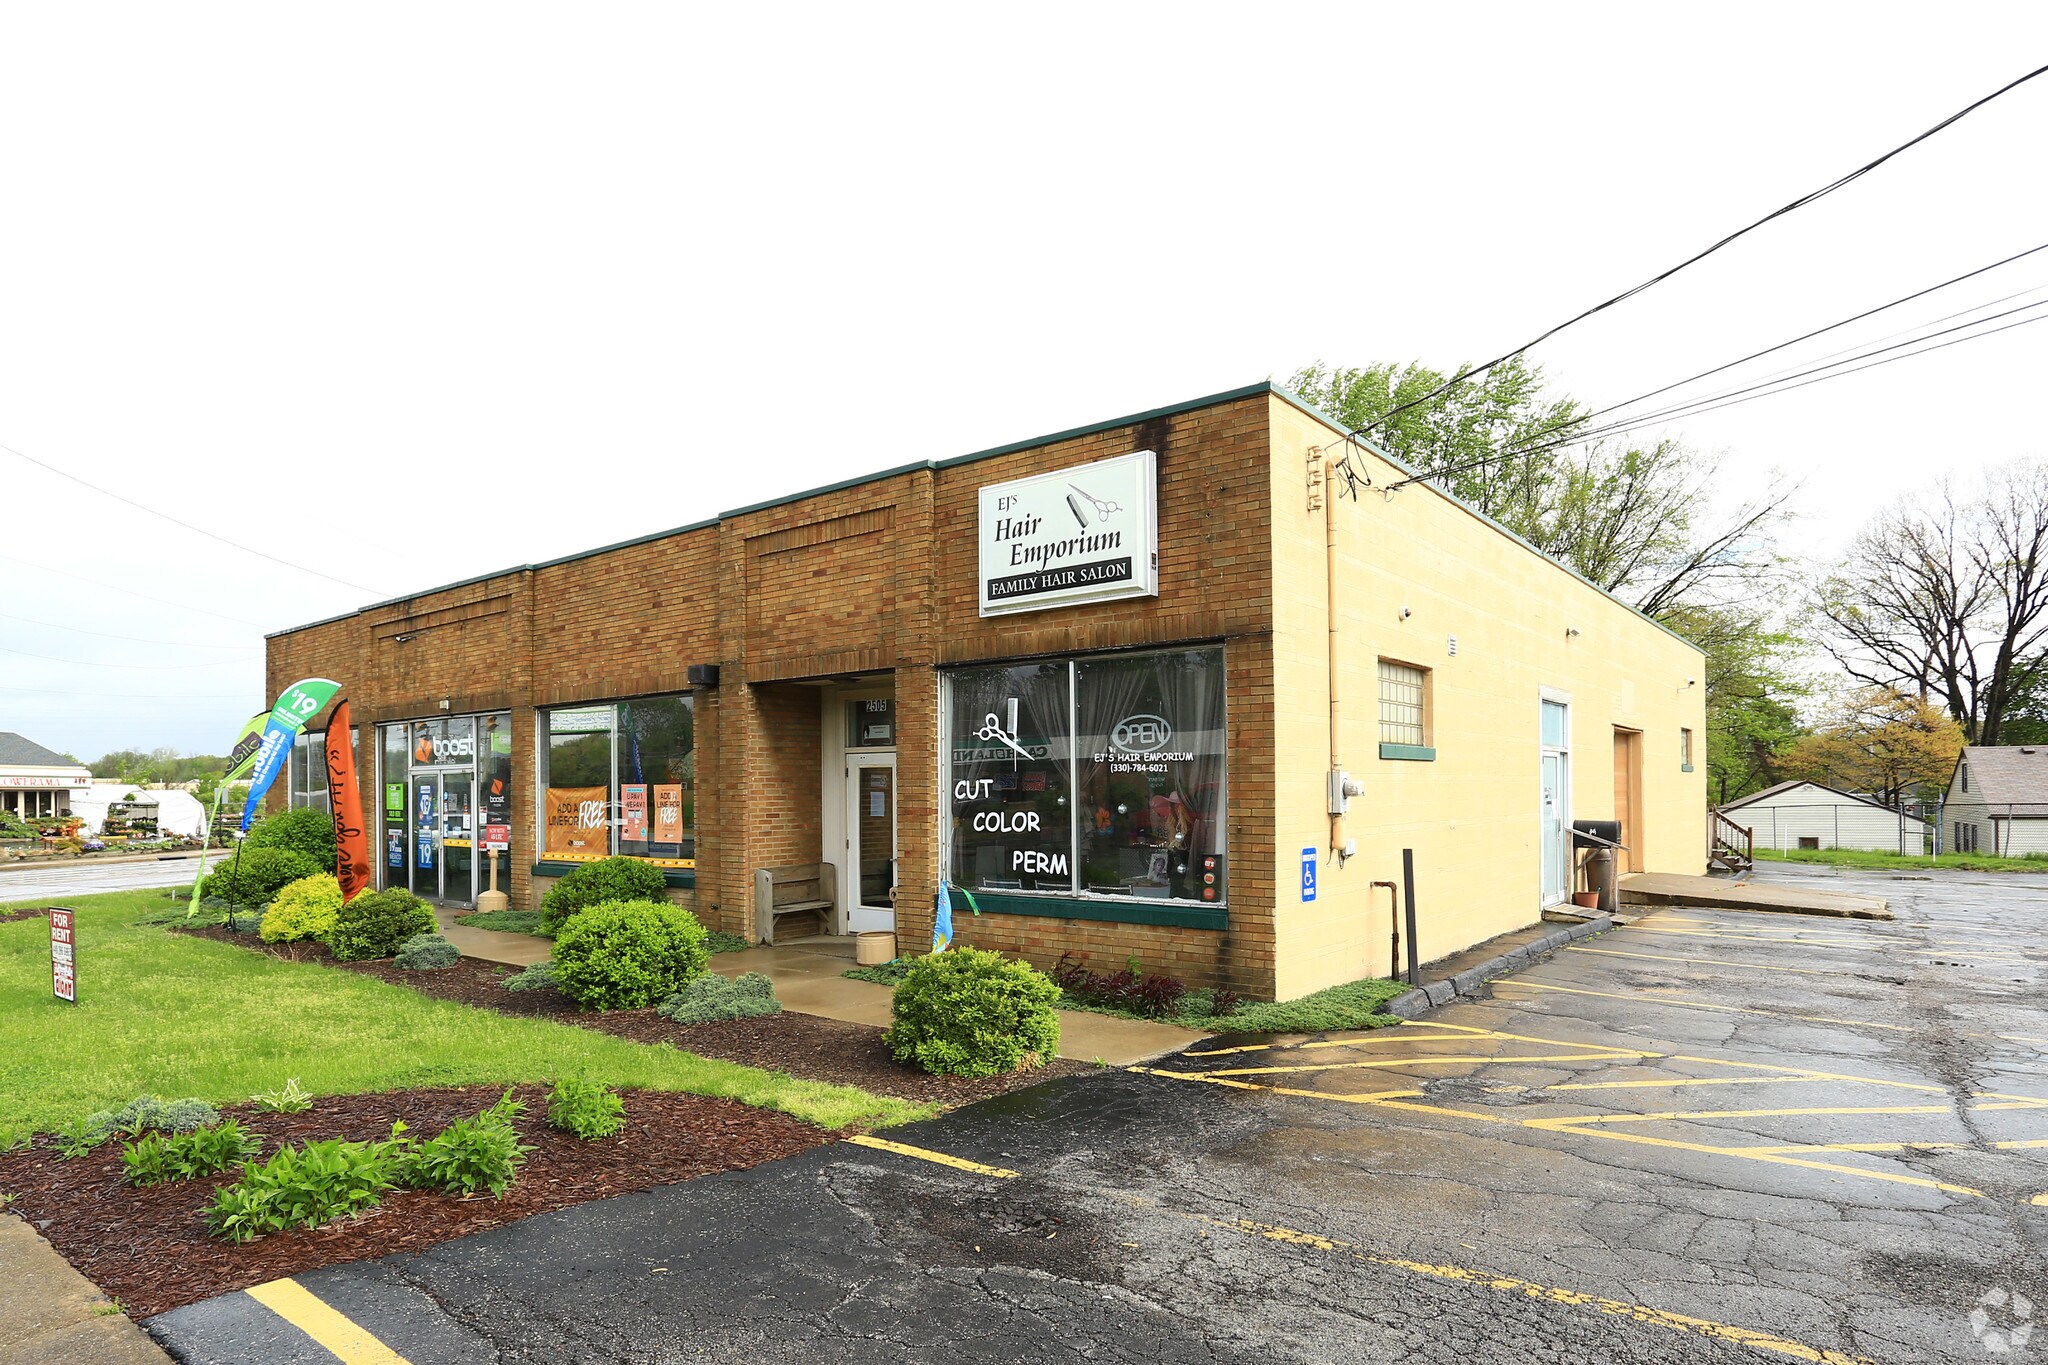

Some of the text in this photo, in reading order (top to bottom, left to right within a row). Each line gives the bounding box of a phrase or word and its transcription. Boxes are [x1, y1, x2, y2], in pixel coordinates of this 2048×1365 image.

[994, 513, 1042, 542] Hair
[1009, 529, 1121, 574] Emporium
[991, 562, 1127, 596] FAMILY HAIR SALON
[866, 699, 887, 712] 2505
[1115, 722, 1166, 745] OPEN
[433, 734, 473, 756] boost
[1094, 752, 1194, 763] EJ'S HAIR EMPORIUM
[1110, 763, 1168, 774] (330)-784-6021
[0, 778, 60, 786] OWERAMA
[955, 779, 994, 800] CUT
[489, 795, 505, 803] boost
[578, 800, 606, 829] FREE
[973, 811, 1041, 833] COLOR
[1012, 850, 1069, 876] PERM
[53, 913, 68, 928] FOR
[52, 927, 70, 943] RENT
